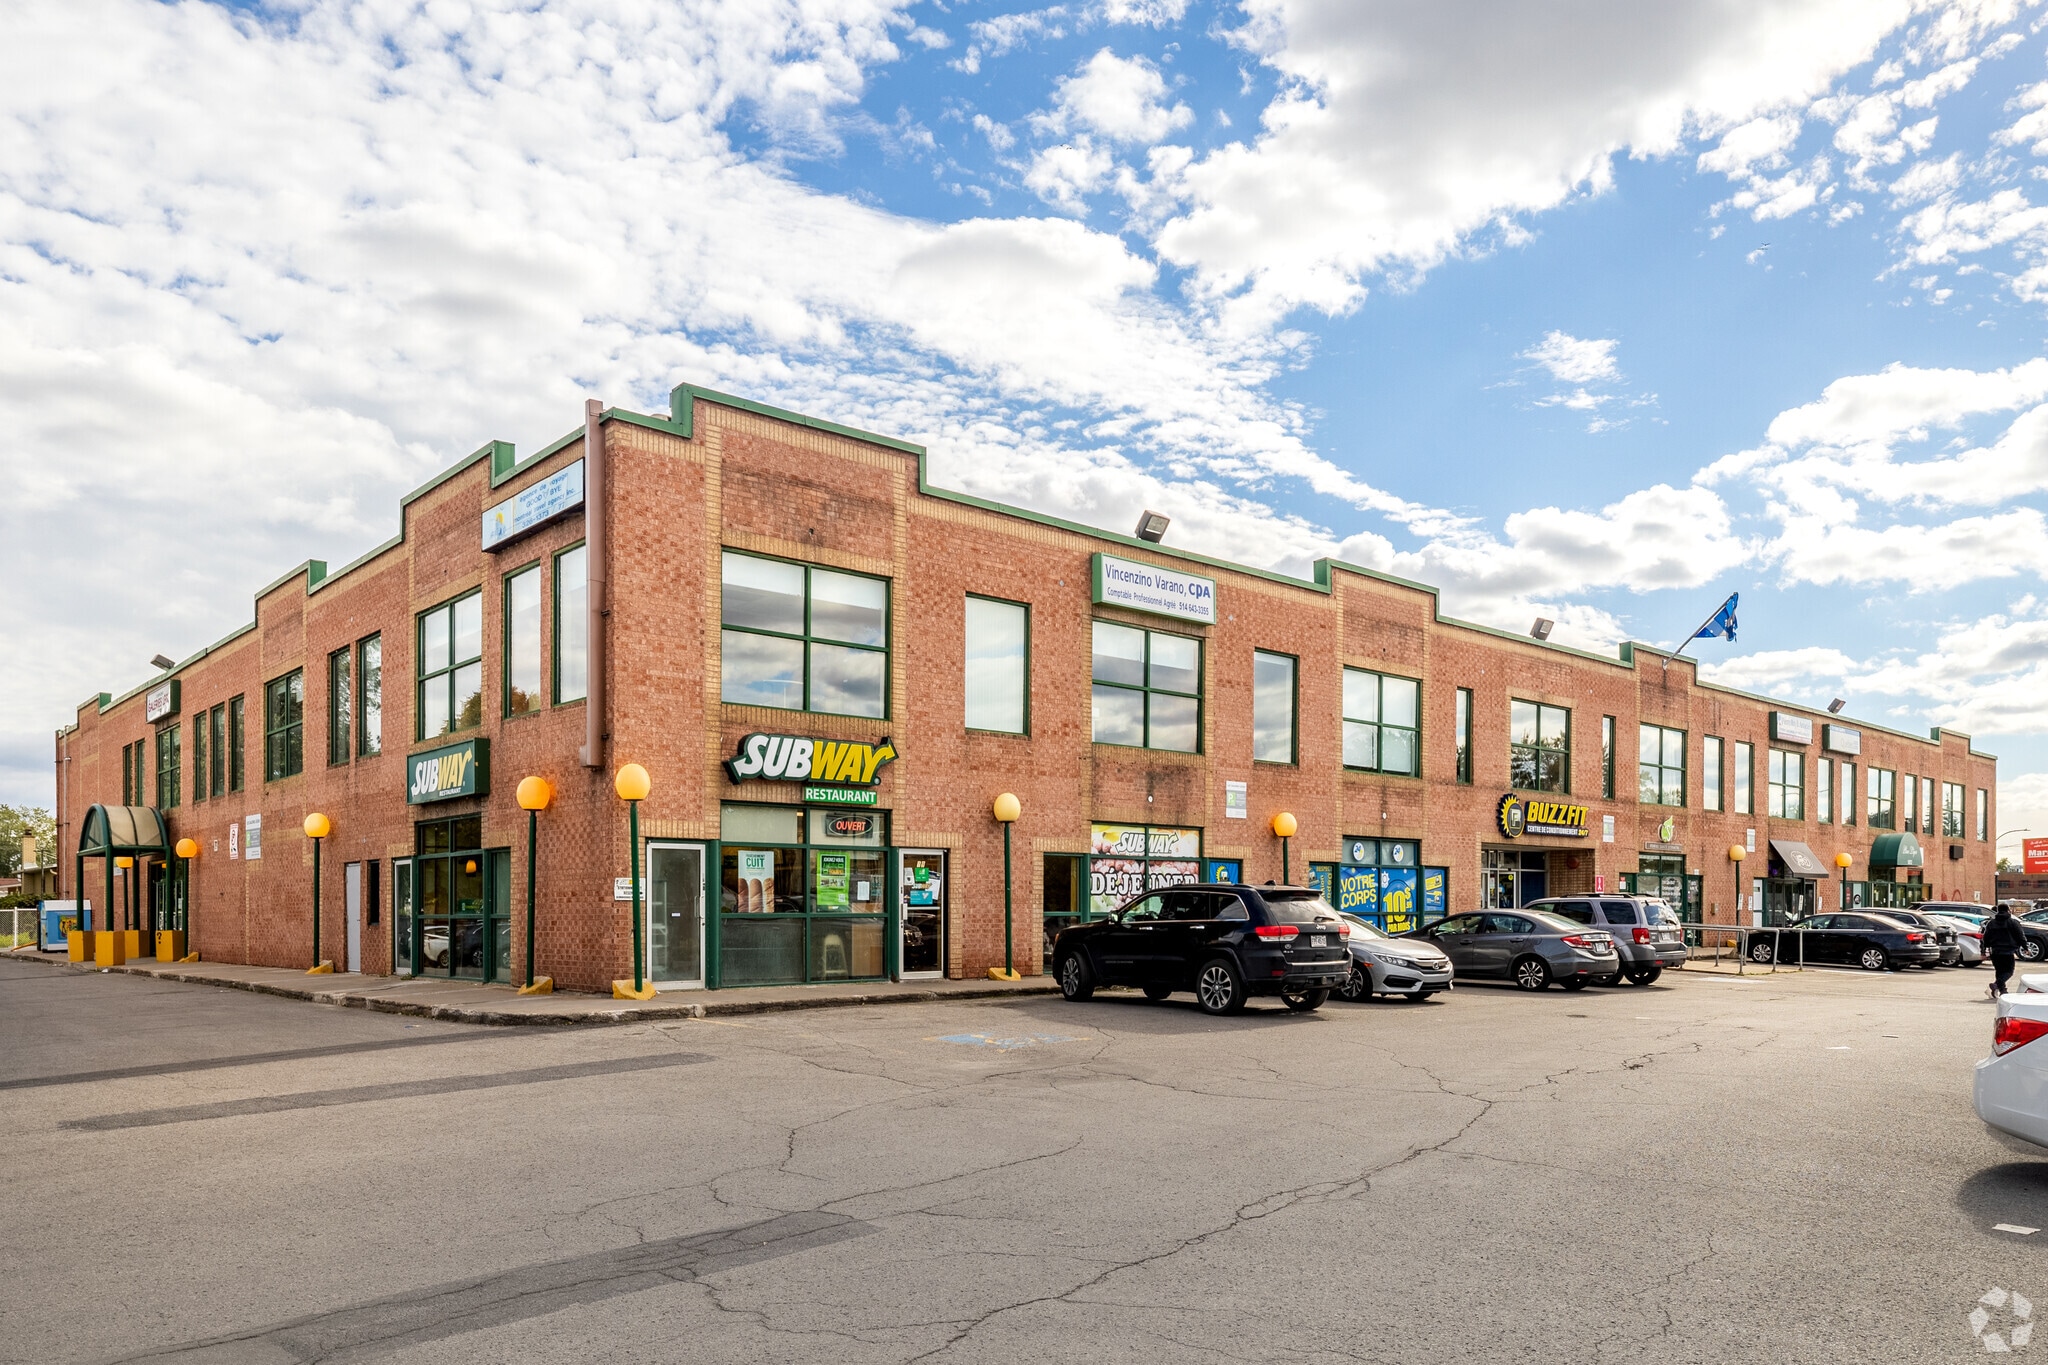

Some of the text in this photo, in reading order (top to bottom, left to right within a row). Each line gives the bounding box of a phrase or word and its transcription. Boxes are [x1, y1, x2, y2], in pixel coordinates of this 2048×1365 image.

[1105, 564, 1152, 587] Vincenzino
[1155, 575, 1187, 597] Varano,
[1107, 587, 1132, 601] Comptable
[1134, 593, 1162, 606] Professionnel
[1179, 602, 1188, 611] 514
[1188, 605, 1209, 616] 643-3355
[733, 734, 896, 784] SUBWAY
[411, 747, 473, 797] SUBWAY
[805, 788, 876, 803] RESTAURANT
[1527, 801, 1589, 826] BUZZFIT
[836, 820, 866, 831] OUVERT
[1115, 832, 1179, 854] SUBWAY
[746, 858, 765, 868] CUIT
[1341, 873, 1376, 893] VOTRE
[1341, 888, 1377, 908] CORPS
